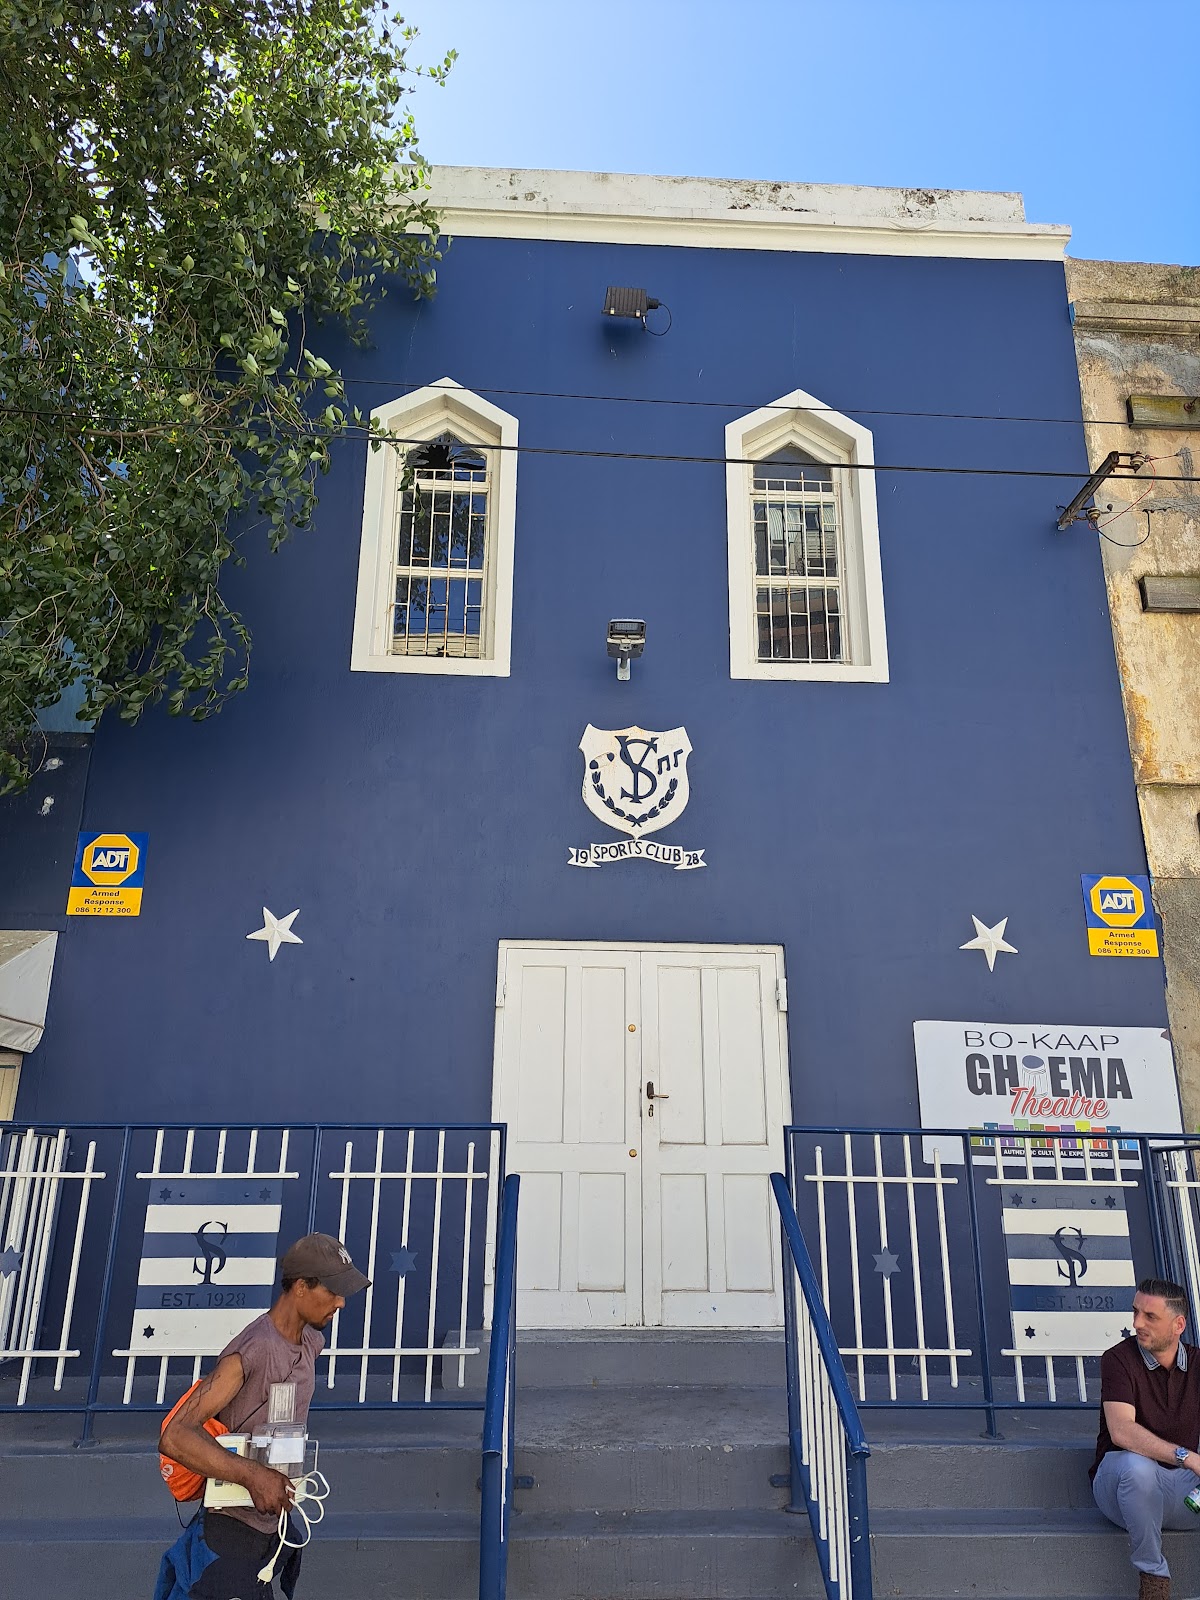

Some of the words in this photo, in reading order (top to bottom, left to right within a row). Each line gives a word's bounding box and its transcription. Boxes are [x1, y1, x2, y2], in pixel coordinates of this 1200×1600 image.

[91, 850, 130, 868] ADT
[575, 849, 589, 863] 19
[645, 843, 682, 862] CLUB
[685, 853, 700, 866] 28
[84, 898, 125, 906] Response
[1101, 892, 1135, 910] ADT
[1104, 939, 1142, 947] Response
[964, 1030, 1120, 1051] BO-KAAP
[1010, 1086, 1109, 1118] Theatre
[160, 1292, 199, 1308] EST.
[206, 1292, 246, 1307] 1928
[1036, 1296, 1072, 1309] EST.
[1077, 1296, 1115, 1309] 1928
